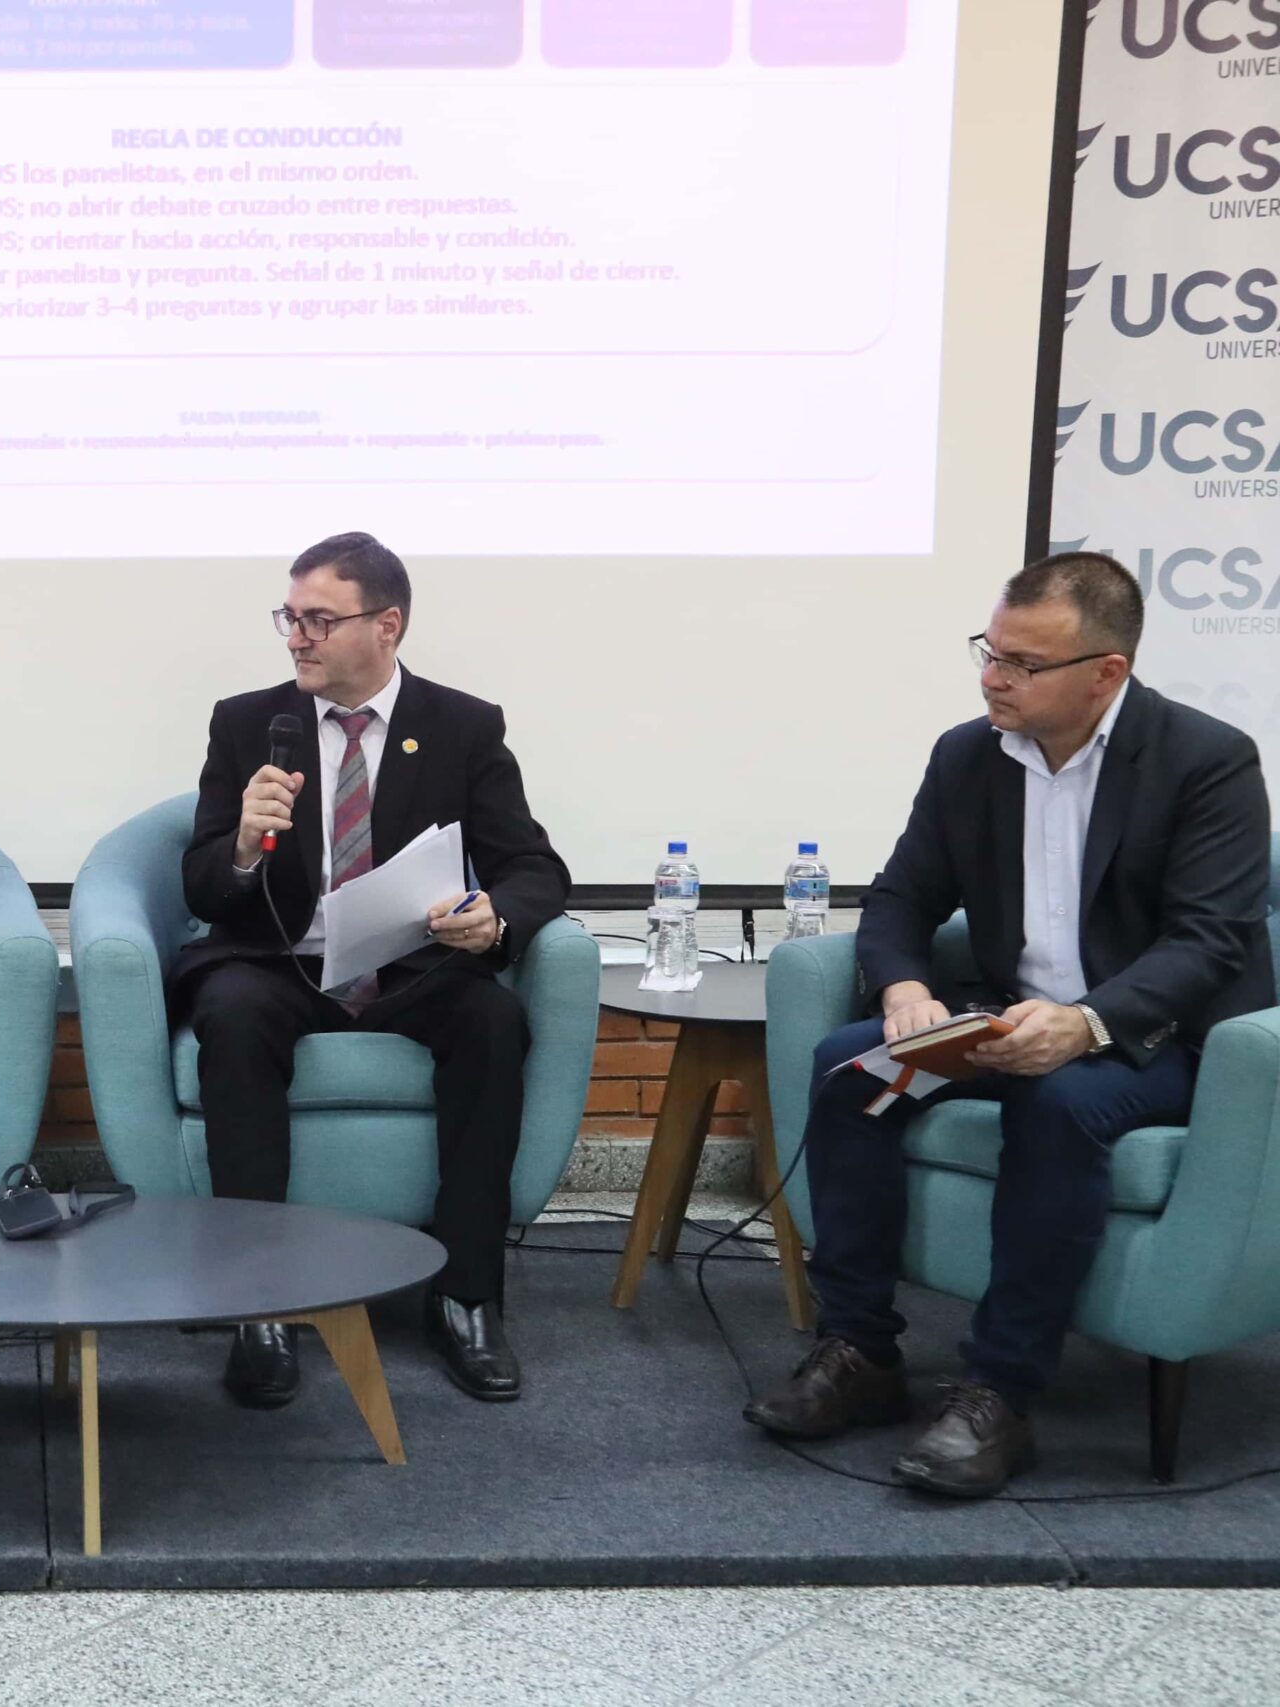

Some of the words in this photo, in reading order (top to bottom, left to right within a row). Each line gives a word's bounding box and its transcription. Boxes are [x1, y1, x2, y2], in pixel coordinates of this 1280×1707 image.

[1218, 56, 1280, 79] UNIVE
[111, 128, 190, 149] REGLA
[195, 128, 228, 148] DE
[233, 122, 402, 148] CONDUCCIÓN
[23, 161, 57, 184] los
[62, 162, 187, 188] panelistas,
[193, 166, 223, 183] en
[229, 160, 251, 182] el
[258, 162, 337, 182] mismo
[343, 160, 418, 181] orden.
[31, 202, 62, 217] no
[68, 196, 122, 217] abrir
[130, 196, 212, 216] debate
[218, 195, 311, 216] cruzado
[317, 197, 380, 215] entre
[386, 196, 518, 218] respuestas.
[31, 230, 126, 250] orientar
[132, 227, 193, 250] hacia
[199, 227, 281, 252] acción,
[288, 226, 430, 253] responsable
[436, 233, 450, 252] y
[456, 225, 576, 248] condición.
[16, 262, 121, 289] panelista
[127, 268, 141, 288] y
[147, 264, 258, 288] pregunta.
[266, 260, 329, 282] Señal
[335, 260, 365, 282] de
[373, 261, 384, 281] 1
[392, 262, 477, 281] minuto
[482, 266, 496, 286] y
[502, 259, 564, 281] señal
[569, 259, 600, 281] de
[605, 260, 680, 281] cierre.
[96, 296, 139, 317] 3–4
[145, 298, 263, 321] preguntas
[268, 300, 282, 320] y
[288, 299, 380, 320] agrupar
[385, 293, 418, 315] las
[423, 293, 534, 315] similares.
[1110, 268, 1280, 338] UCS
[1206, 339, 1280, 360] UNIVER
